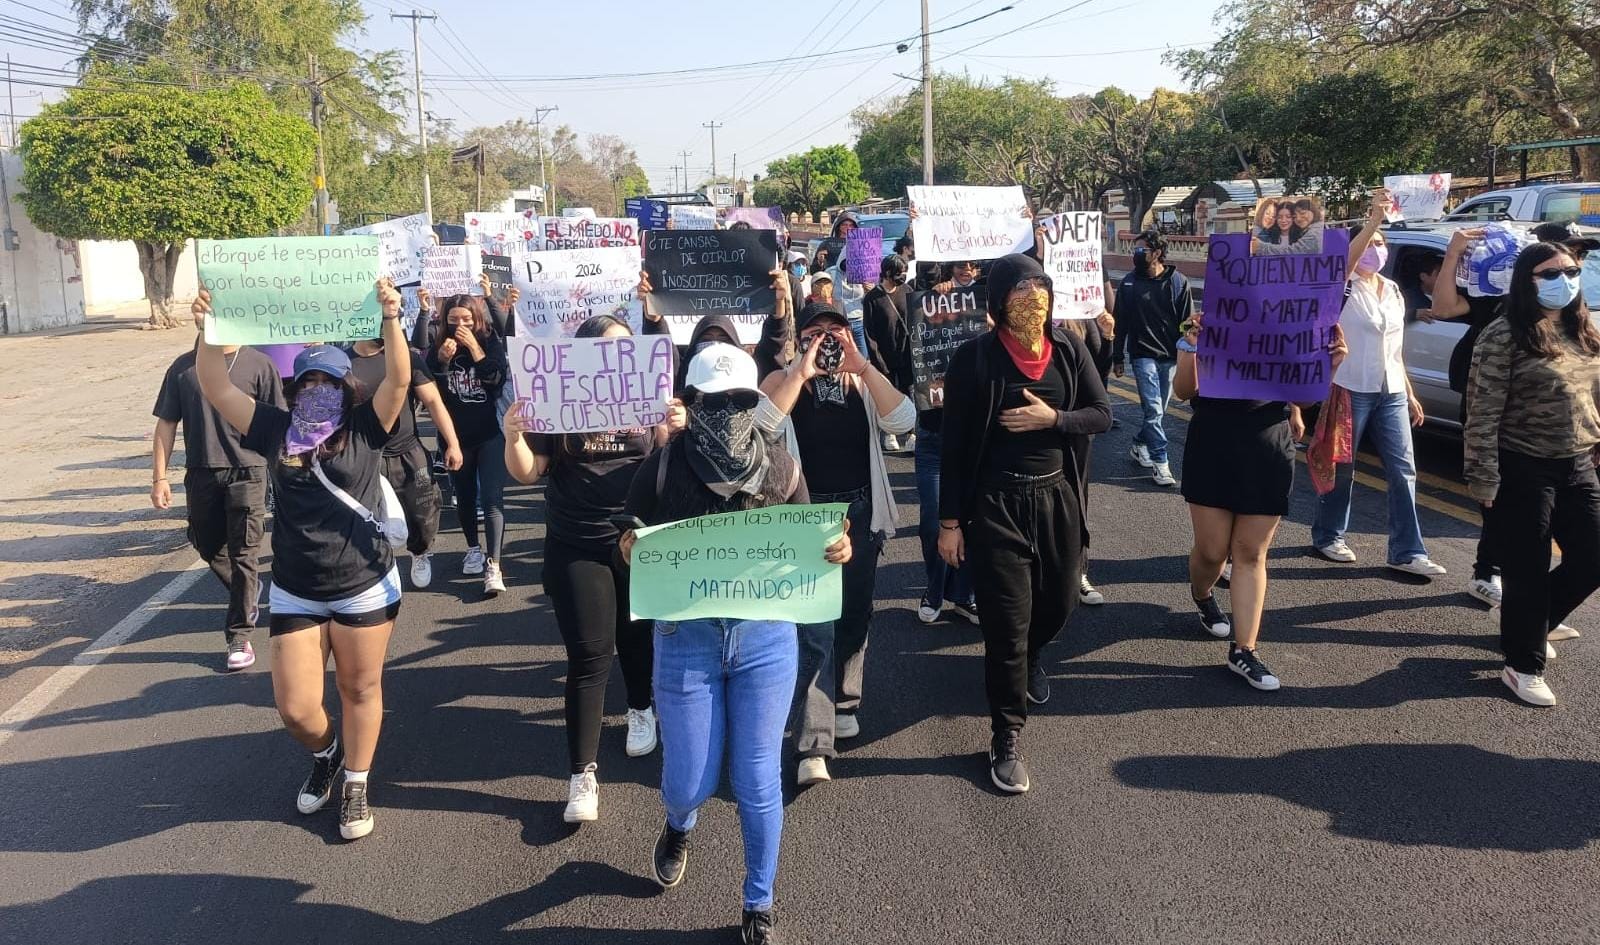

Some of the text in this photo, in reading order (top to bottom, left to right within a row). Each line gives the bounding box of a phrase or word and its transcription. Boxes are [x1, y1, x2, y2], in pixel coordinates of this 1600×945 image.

[545, 223, 632, 239] EL MIEDO NO
[952, 220, 970, 234] NO
[1042, 213, 1100, 245] UAEM
[648, 232, 720, 250] ¿TE CANSAS
[932, 232, 1013, 253] Asesinados
[273, 244, 288, 260] te
[296, 243, 378, 266] espantas
[681, 249, 746, 266] DE OIRLO?
[482, 260, 510, 272] erdonen
[526, 261, 552, 282] Por
[575, 264, 602, 278] 2026
[1228, 254, 1346, 286] QUIEN AMA
[241, 273, 268, 289] las
[273, 276, 302, 295] que
[310, 271, 377, 286] LUCHAN
[662, 270, 752, 290] ¡NOSOTRAS DE
[222, 306, 246, 318] no
[253, 302, 286, 322] por
[294, 300, 320, 312] las
[328, 300, 362, 320] que
[528, 292, 632, 310] no nos cueste la
[689, 297, 751, 312] VIVIRLO!
[922, 291, 976, 318] UAEM
[1216, 298, 1318, 324] NO MATA
[270, 319, 342, 338] MUEREN?
[348, 317, 375, 327] CTM
[910, 320, 982, 342] ¿Por qué te
[1205, 326, 1230, 350] NI
[522, 338, 671, 375] QUE IR A
[927, 359, 942, 370] que
[1226, 359, 1324, 384] MALTRATA
[514, 372, 672, 404] LA ESCUELA
[515, 402, 536, 418] NO
[560, 402, 632, 432] CUESTE
[632, 402, 650, 413] LA
[634, 412, 666, 426] VID
[744, 511, 772, 526] las
[638, 541, 796, 569] es que nos están
[690, 574, 816, 600] MATANDO !!!
